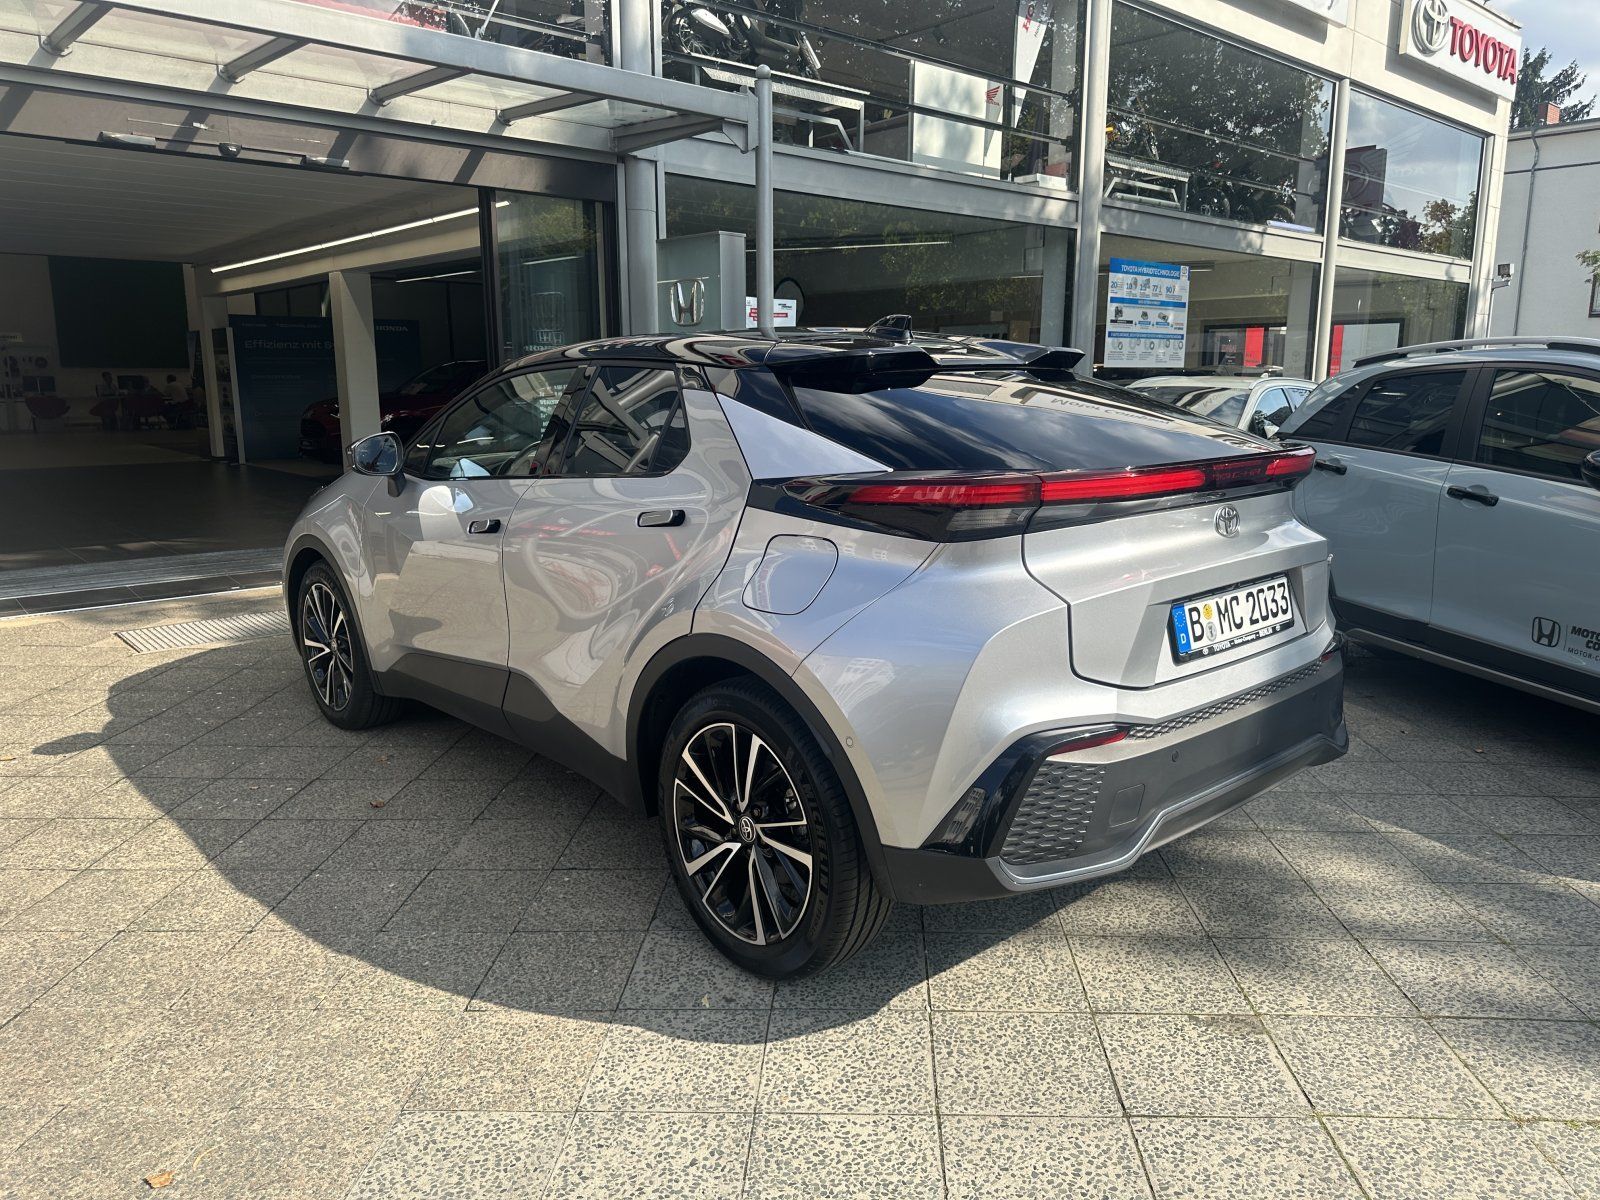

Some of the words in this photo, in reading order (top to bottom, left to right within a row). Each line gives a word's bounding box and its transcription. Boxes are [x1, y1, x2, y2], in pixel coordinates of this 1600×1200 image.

[1449, 16, 1517, 85] TOYOTA
[1121, 264, 1138, 273] TOYOTA
[244, 339, 301, 349] Effizienz
[303, 339, 322, 349] mit
[1188, 606, 1205, 643] B
[1215, 595, 1244, 635] MC
[1245, 581, 1290, 626] 2033
[1180, 633, 1187, 644] D
[1213, 640, 1232, 652] TOYOTA
